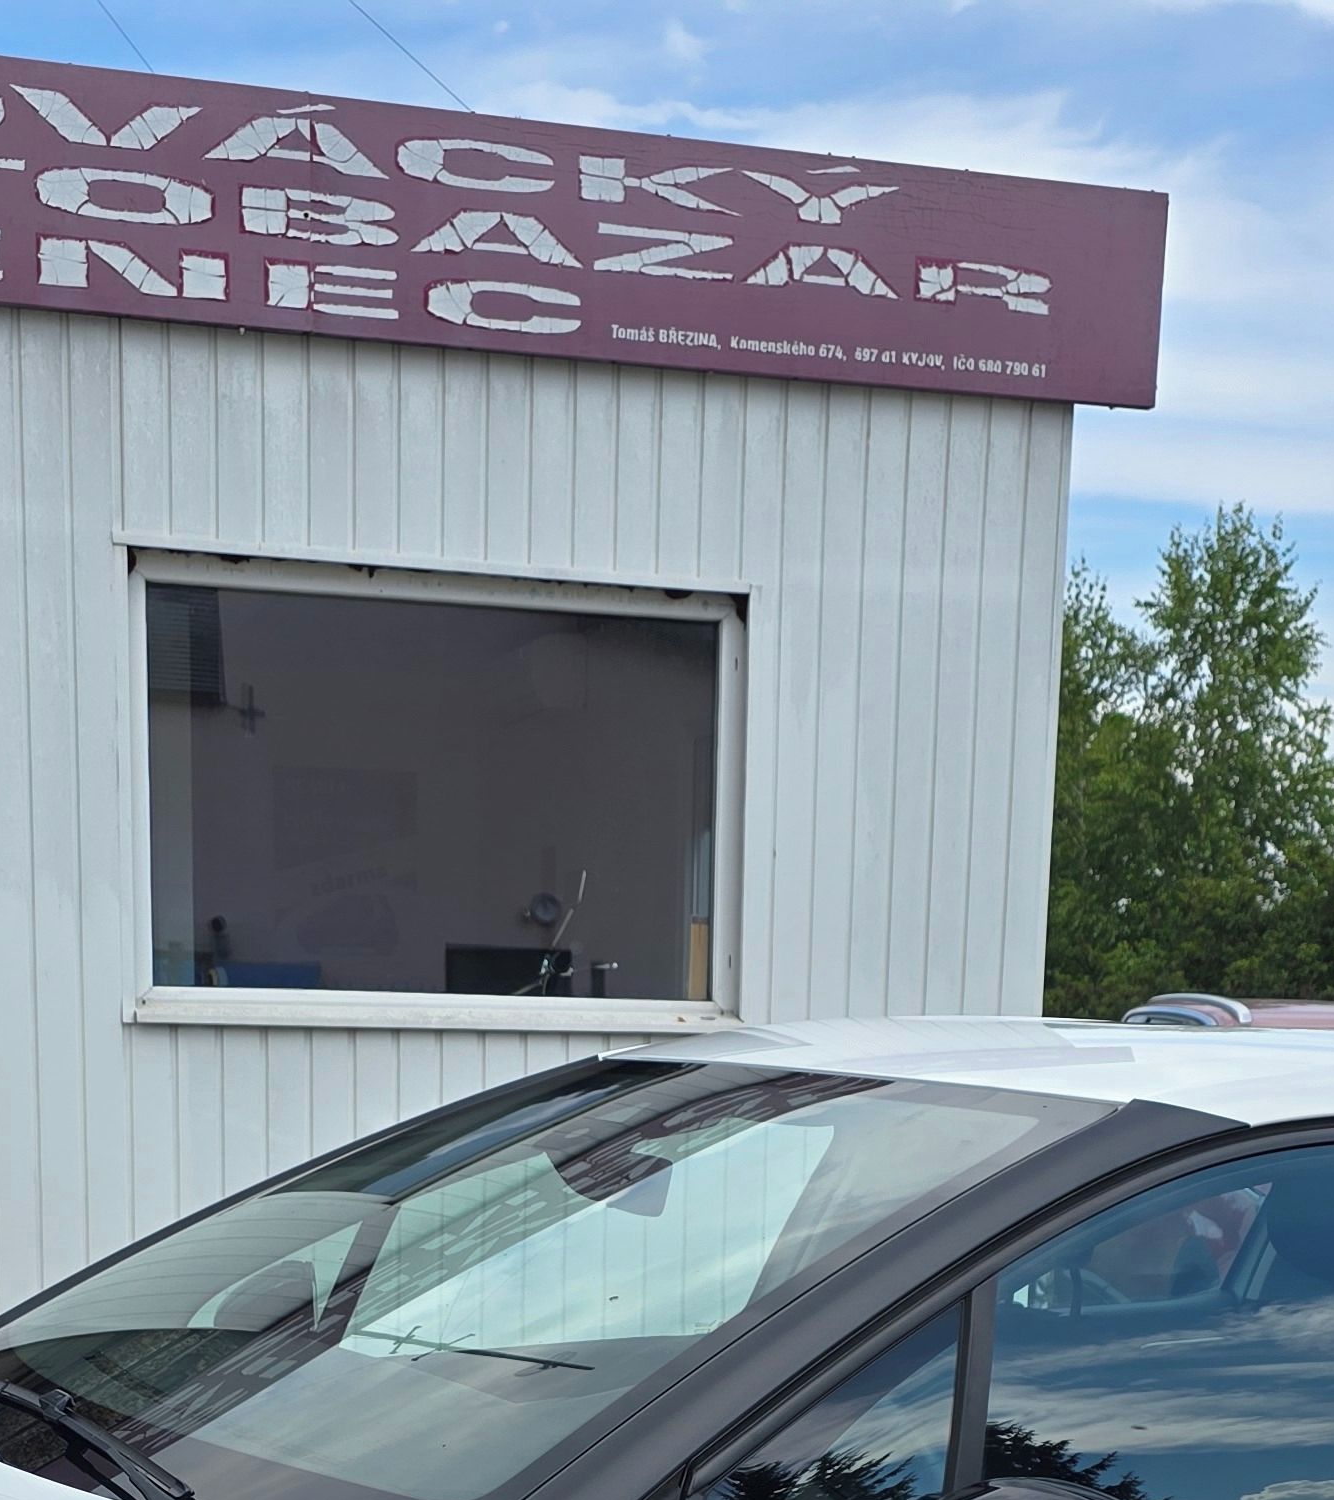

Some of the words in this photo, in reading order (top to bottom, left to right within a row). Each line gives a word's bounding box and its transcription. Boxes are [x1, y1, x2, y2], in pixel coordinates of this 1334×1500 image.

[611, 324, 655, 342] Tomáš
[658, 326, 722, 350] BŘEZINA,
[1032, 364, 1046, 378] 61
